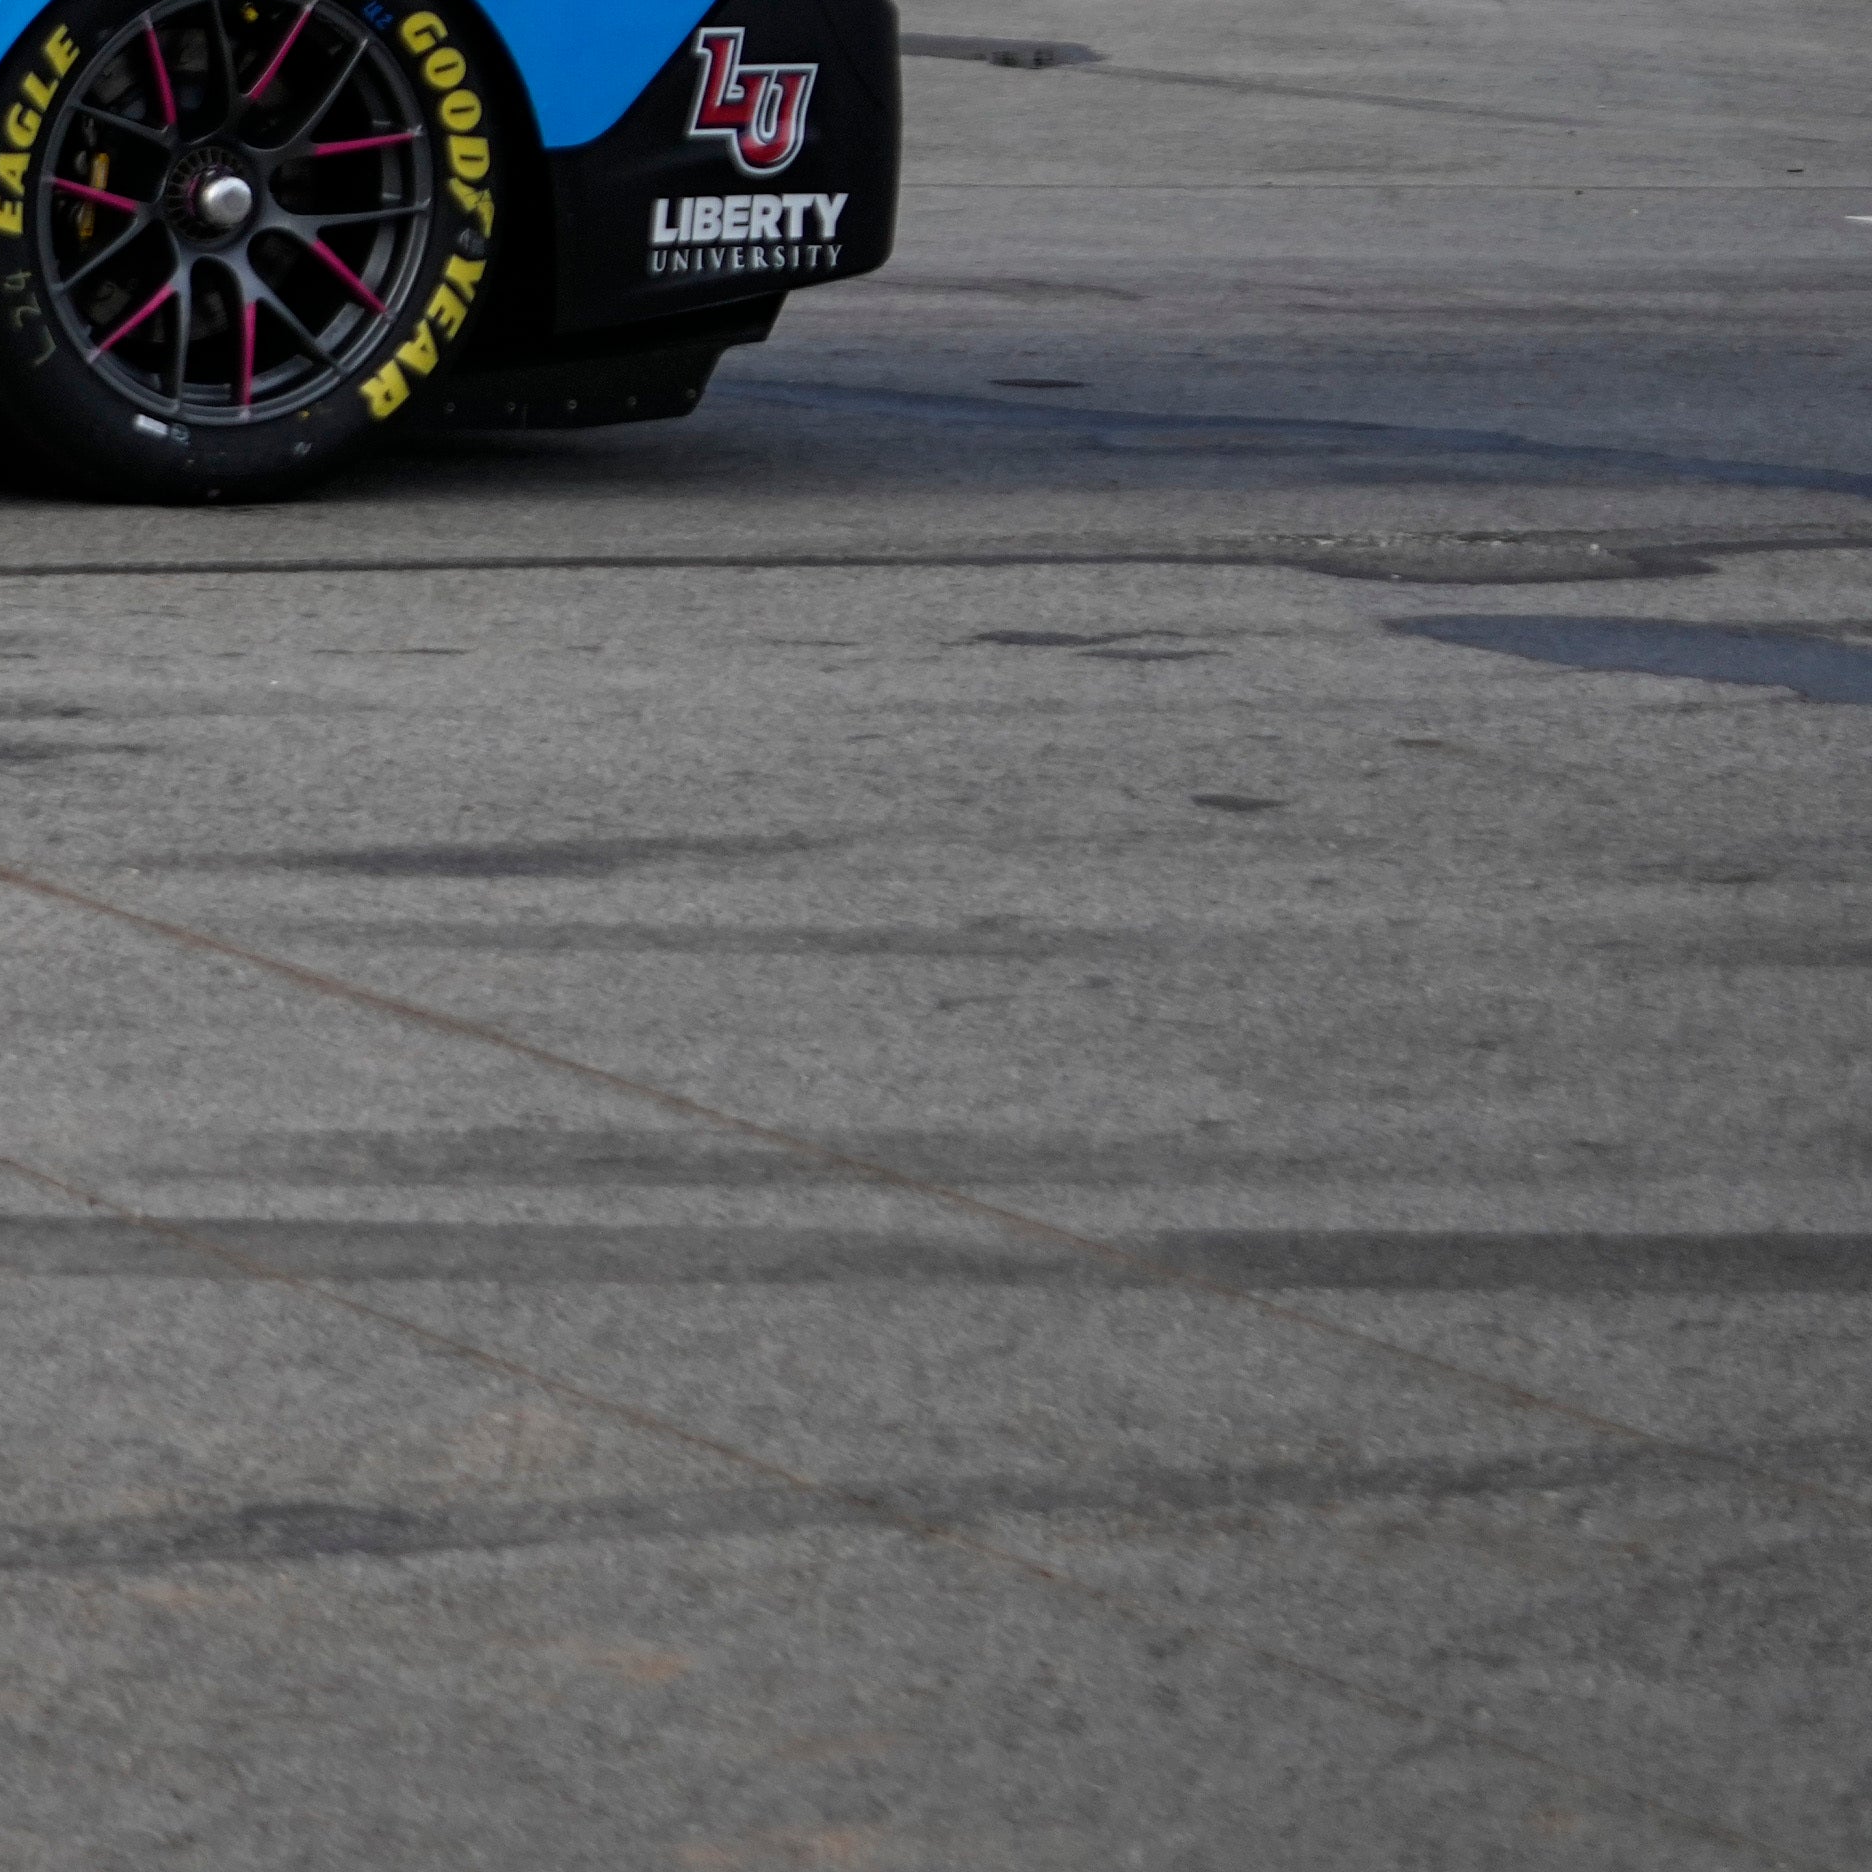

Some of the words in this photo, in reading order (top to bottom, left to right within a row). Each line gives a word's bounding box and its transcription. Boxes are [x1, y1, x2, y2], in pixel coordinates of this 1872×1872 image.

[688, 26, 819, 173] LU
[359, 10, 496, 420] GOODYEAR
[650, 191, 850, 246] LIBERTY
[652, 244, 844, 274] UNIVERSITY
